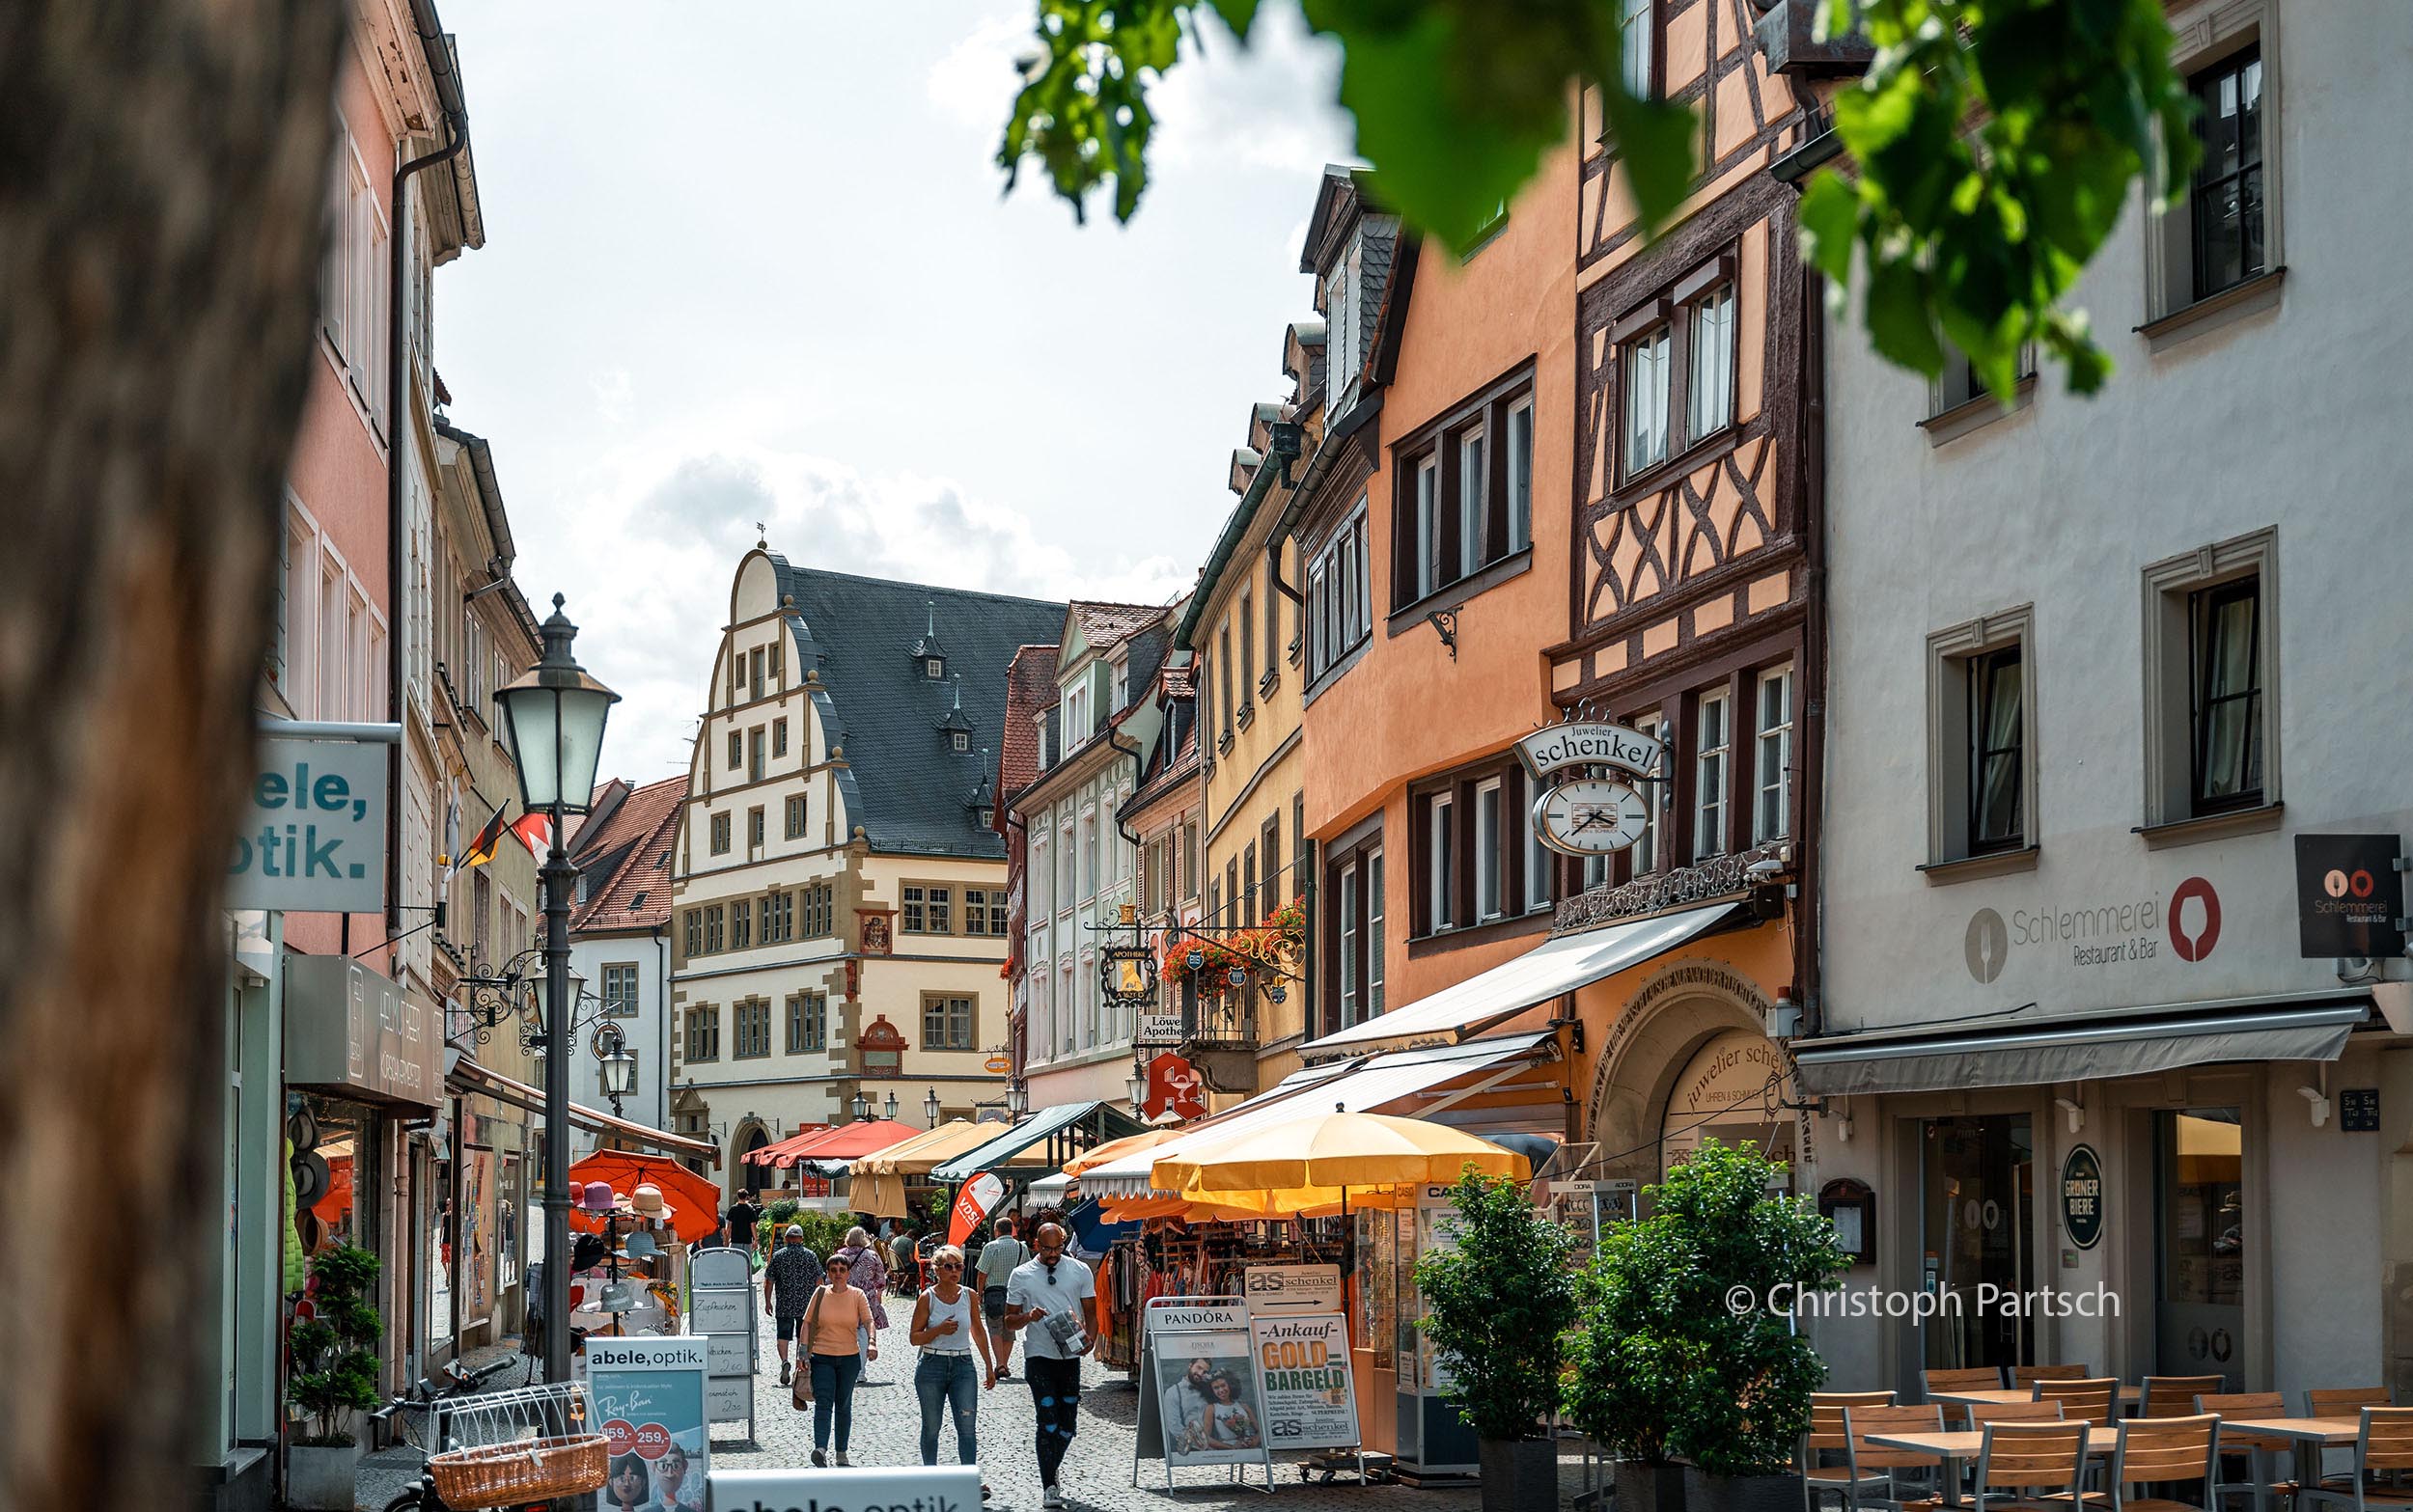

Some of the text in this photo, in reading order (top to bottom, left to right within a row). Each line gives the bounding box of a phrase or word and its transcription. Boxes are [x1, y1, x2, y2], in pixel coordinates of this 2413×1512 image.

[1571, 726, 1612, 737] Juwelier
[1535, 734, 1653, 768] schenkel
[254, 761, 368, 822] ele,
[226, 824, 367, 879] tik.
[2315, 899, 2388, 914] Schlemmerei
[2013, 891, 2160, 946] Schlemmerei
[2346, 915, 2372, 923] Restaurant
[2073, 937, 2159, 968] Restaurant & Bar
[1151, 1016, 1181, 1026] Löwe
[1143, 1026, 1183, 1037] Apothe
[1687, 1047, 1740, 1111] juwelier
[1706, 1090, 1724, 1103] UHREN
[1397, 1186, 1415, 1197] CASIO
[958, 1196, 981, 1227] VDSL
[2069, 1198, 2094, 1215] BIERE
[1285, 1276, 1337, 1286] schenkel
[1165, 1311, 1234, 1325] PANDORA
[592, 1349, 703, 1366] abele, optik.
[1264, 1369, 1345, 1391] BARGELD
[1302, 1422, 1349, 1431] schenkel
[637, 1432, 669, 1444] 259,-
